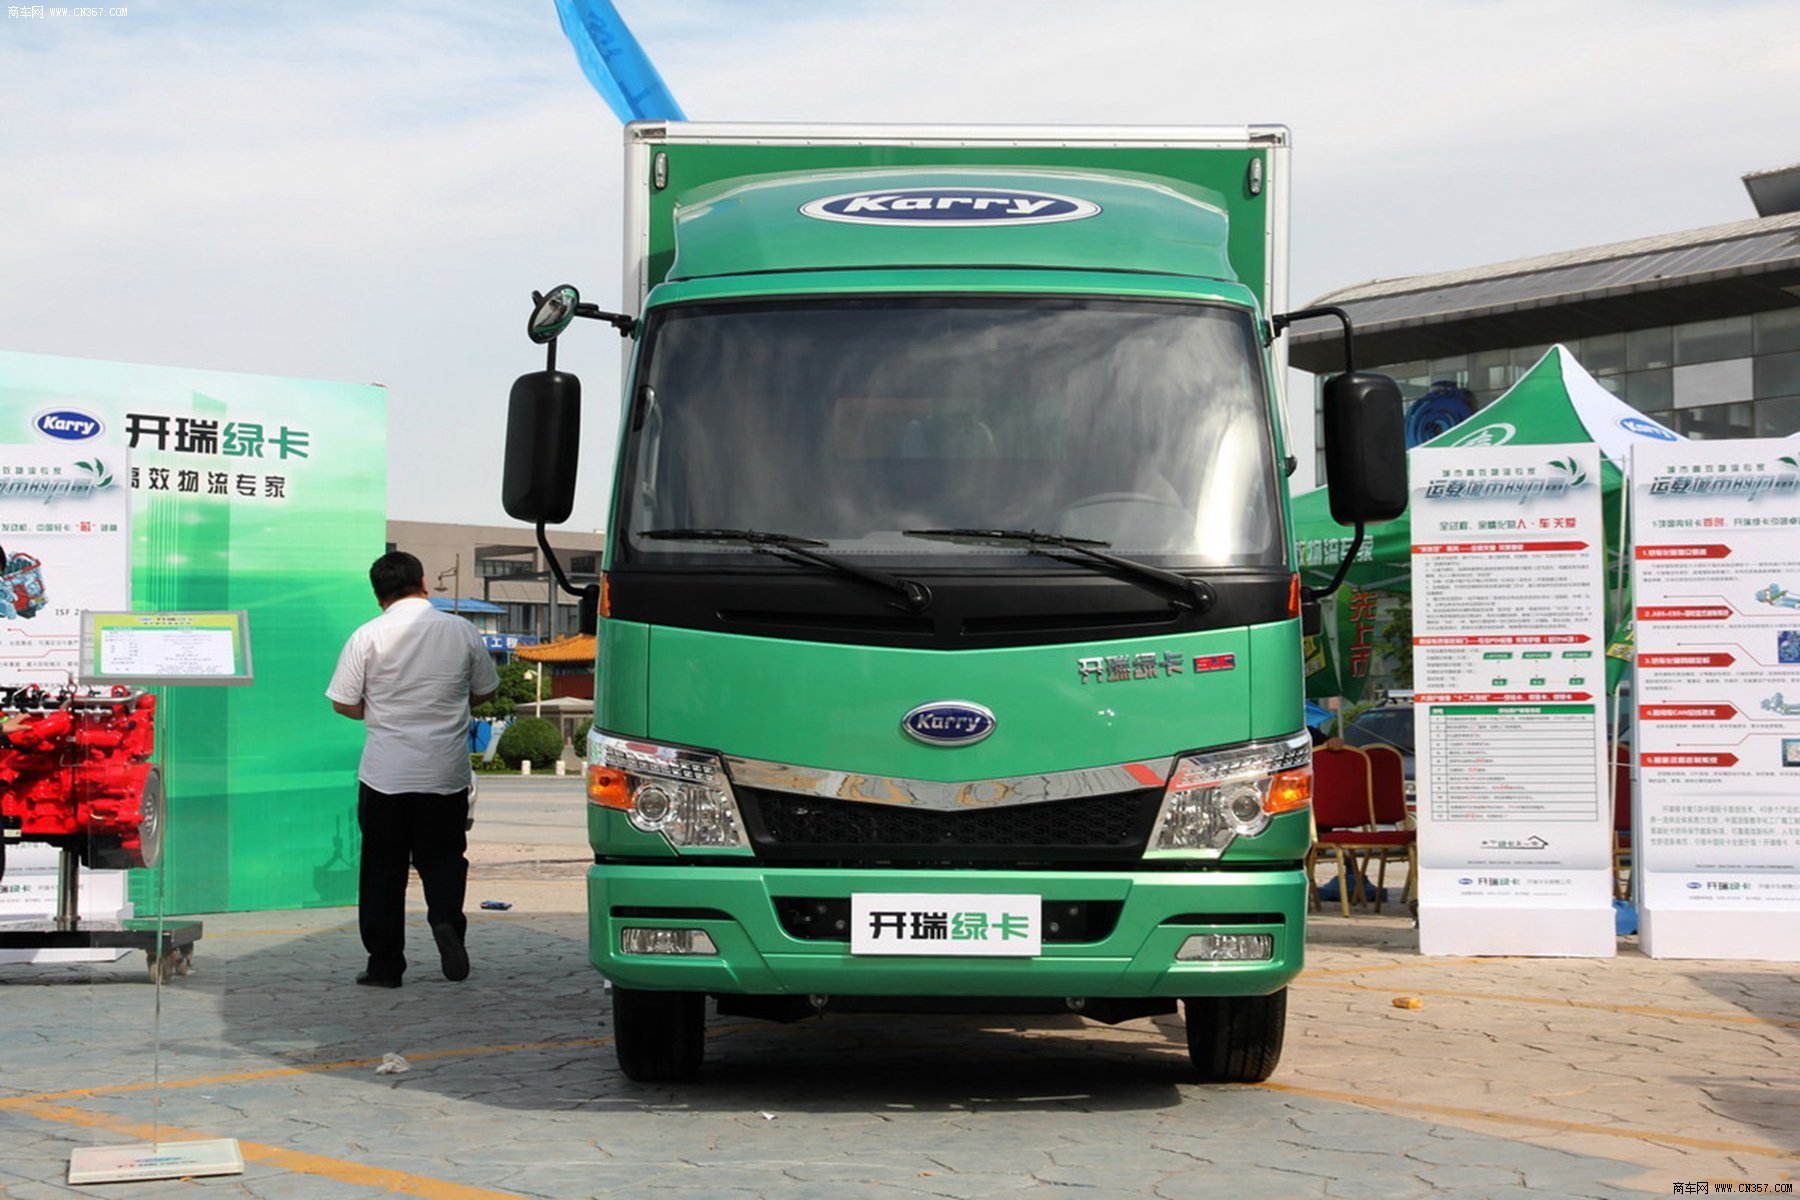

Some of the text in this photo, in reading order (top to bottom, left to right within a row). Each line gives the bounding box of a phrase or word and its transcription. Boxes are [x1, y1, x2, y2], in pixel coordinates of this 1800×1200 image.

[843, 195, 1058, 215] Karry
[43, 414, 96, 435] Karry
[126, 413, 310, 459] 开瑞绿卡
[1077, 650, 1185, 684] 开瑞绿卡
[916, 712, 981, 733] Karry
[869, 911, 1029, 941] 开瑞绿卡
